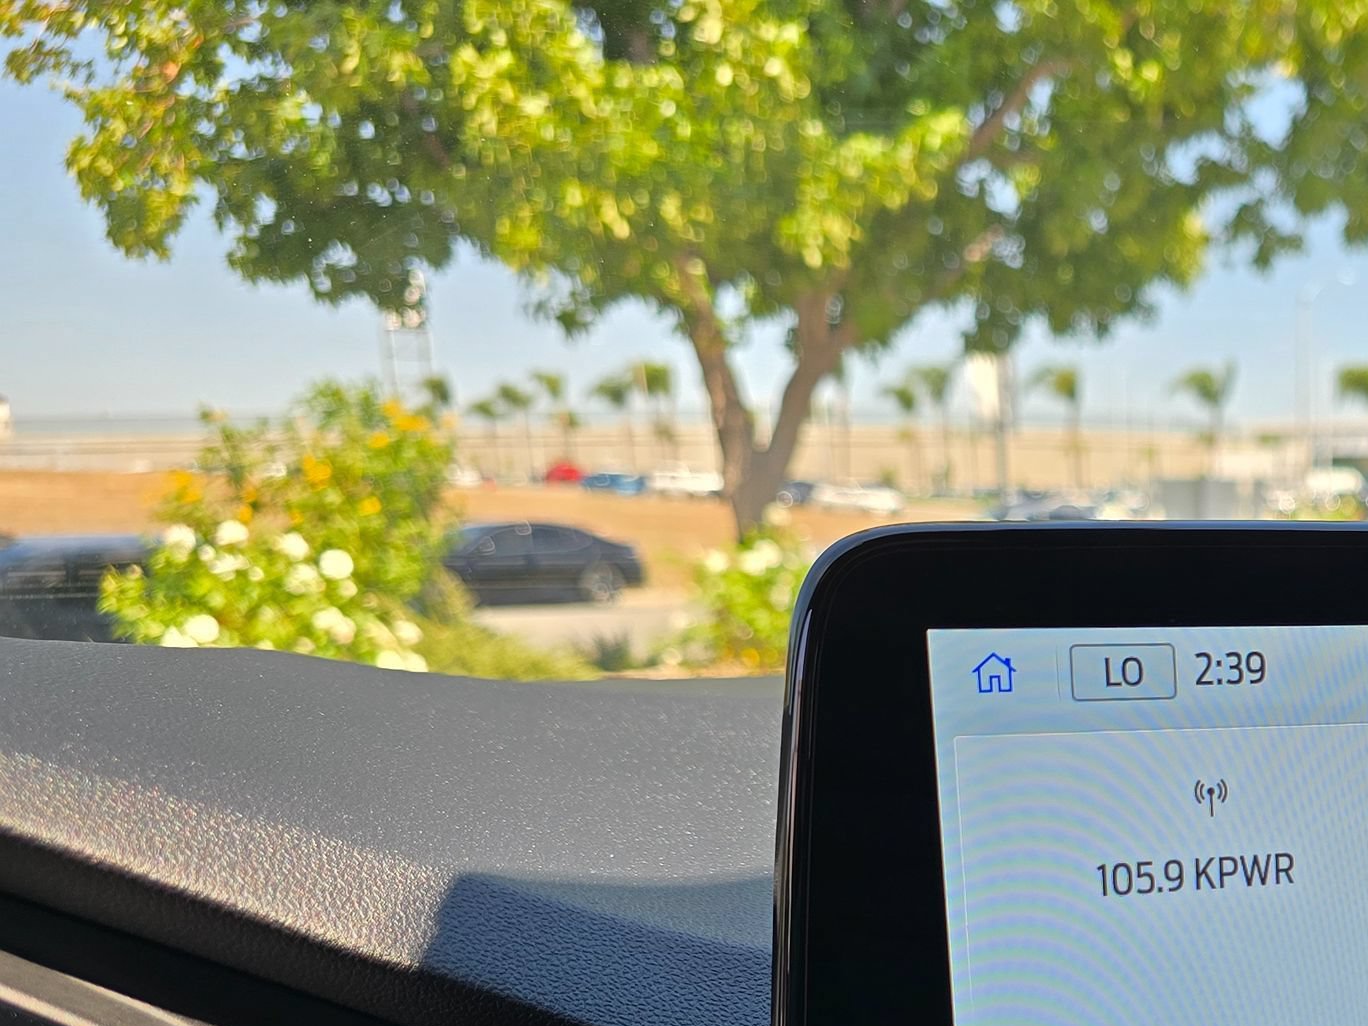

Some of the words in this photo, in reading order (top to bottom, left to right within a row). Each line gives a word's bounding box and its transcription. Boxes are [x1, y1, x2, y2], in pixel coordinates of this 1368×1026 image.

[1104, 656, 1144, 687] LO
[1194, 651, 1266, 686] 2:39
[1096, 859, 1185, 896] 105.9
[1194, 852, 1295, 890] KPWR
